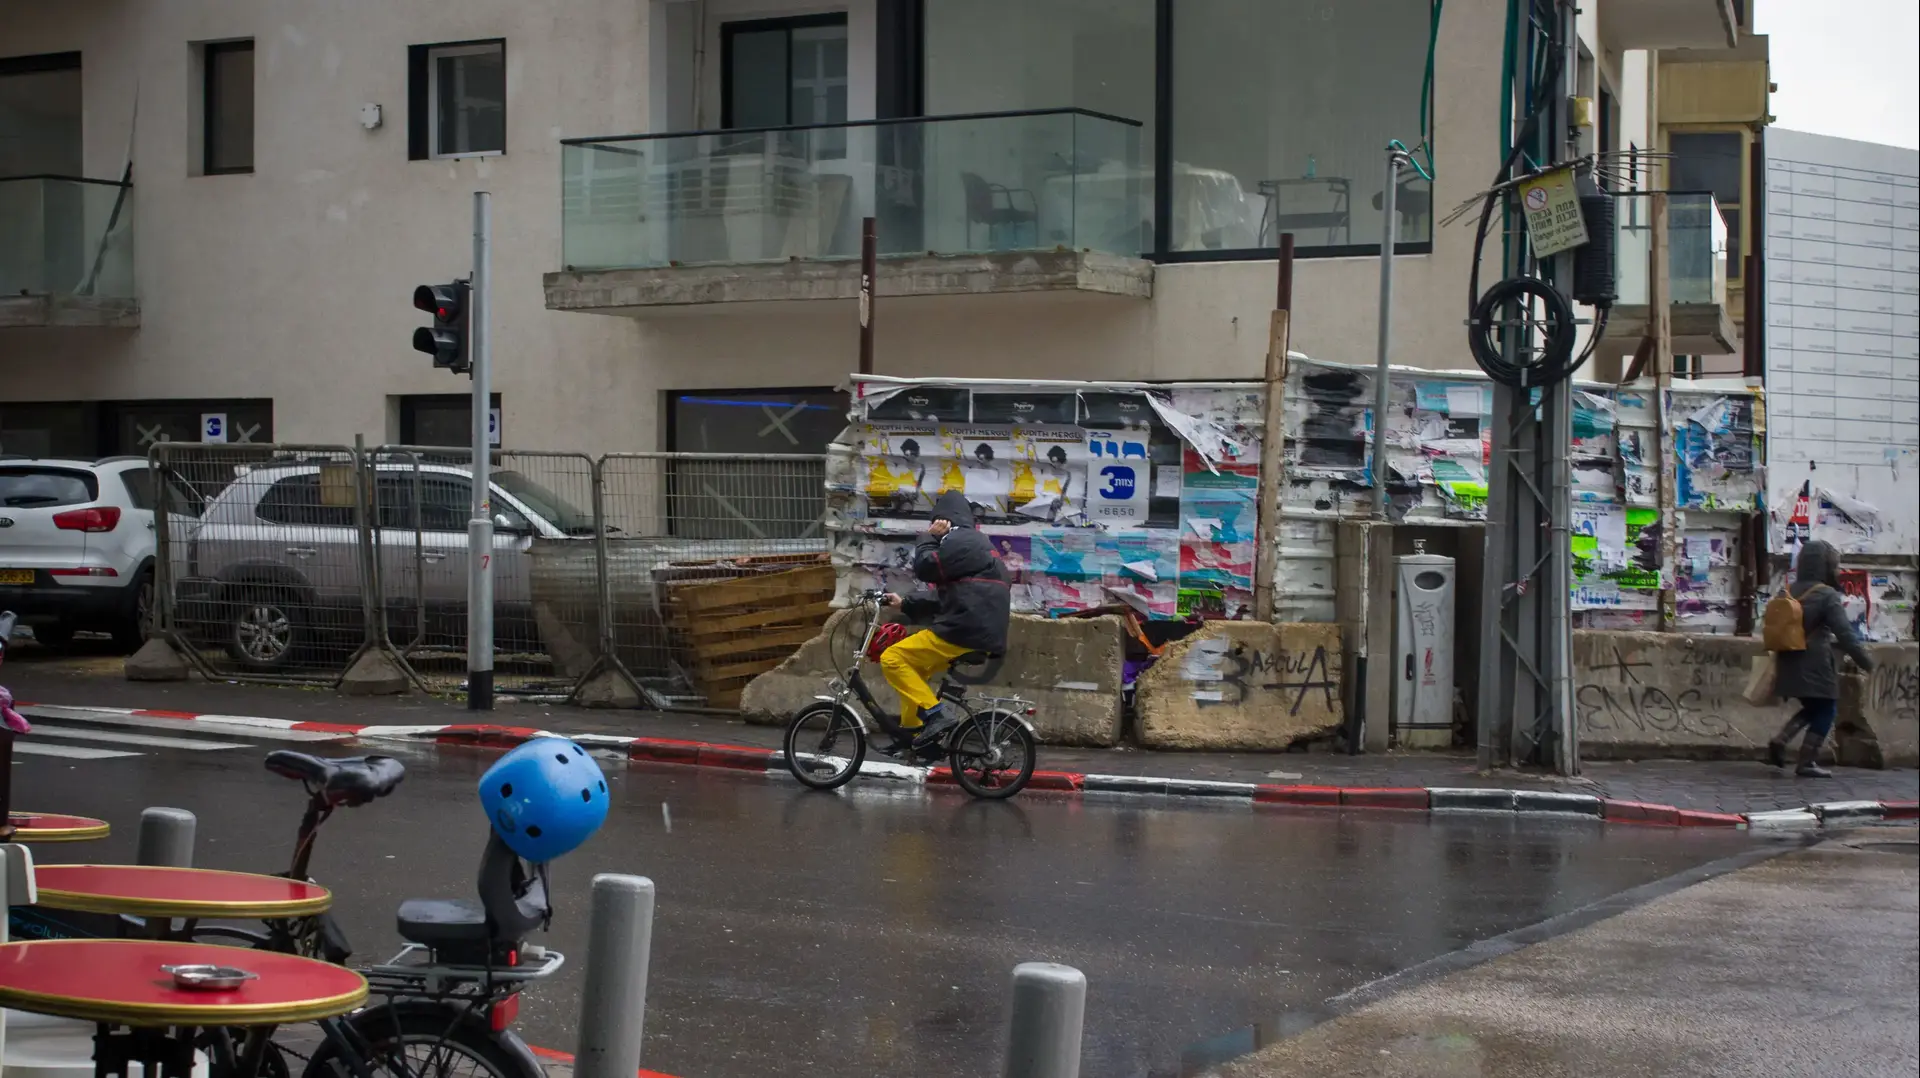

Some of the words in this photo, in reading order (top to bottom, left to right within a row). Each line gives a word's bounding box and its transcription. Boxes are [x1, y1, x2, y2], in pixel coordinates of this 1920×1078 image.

[1555, 200, 1575, 213] מתח
[1530, 208, 1552, 223] גבוה
[1556, 209, 1578, 224] סכנת
[1534, 229, 1554, 242] Danger
[1018, 429, 1049, 438] JUDITH
[1114, 478, 1133, 487] צוות
